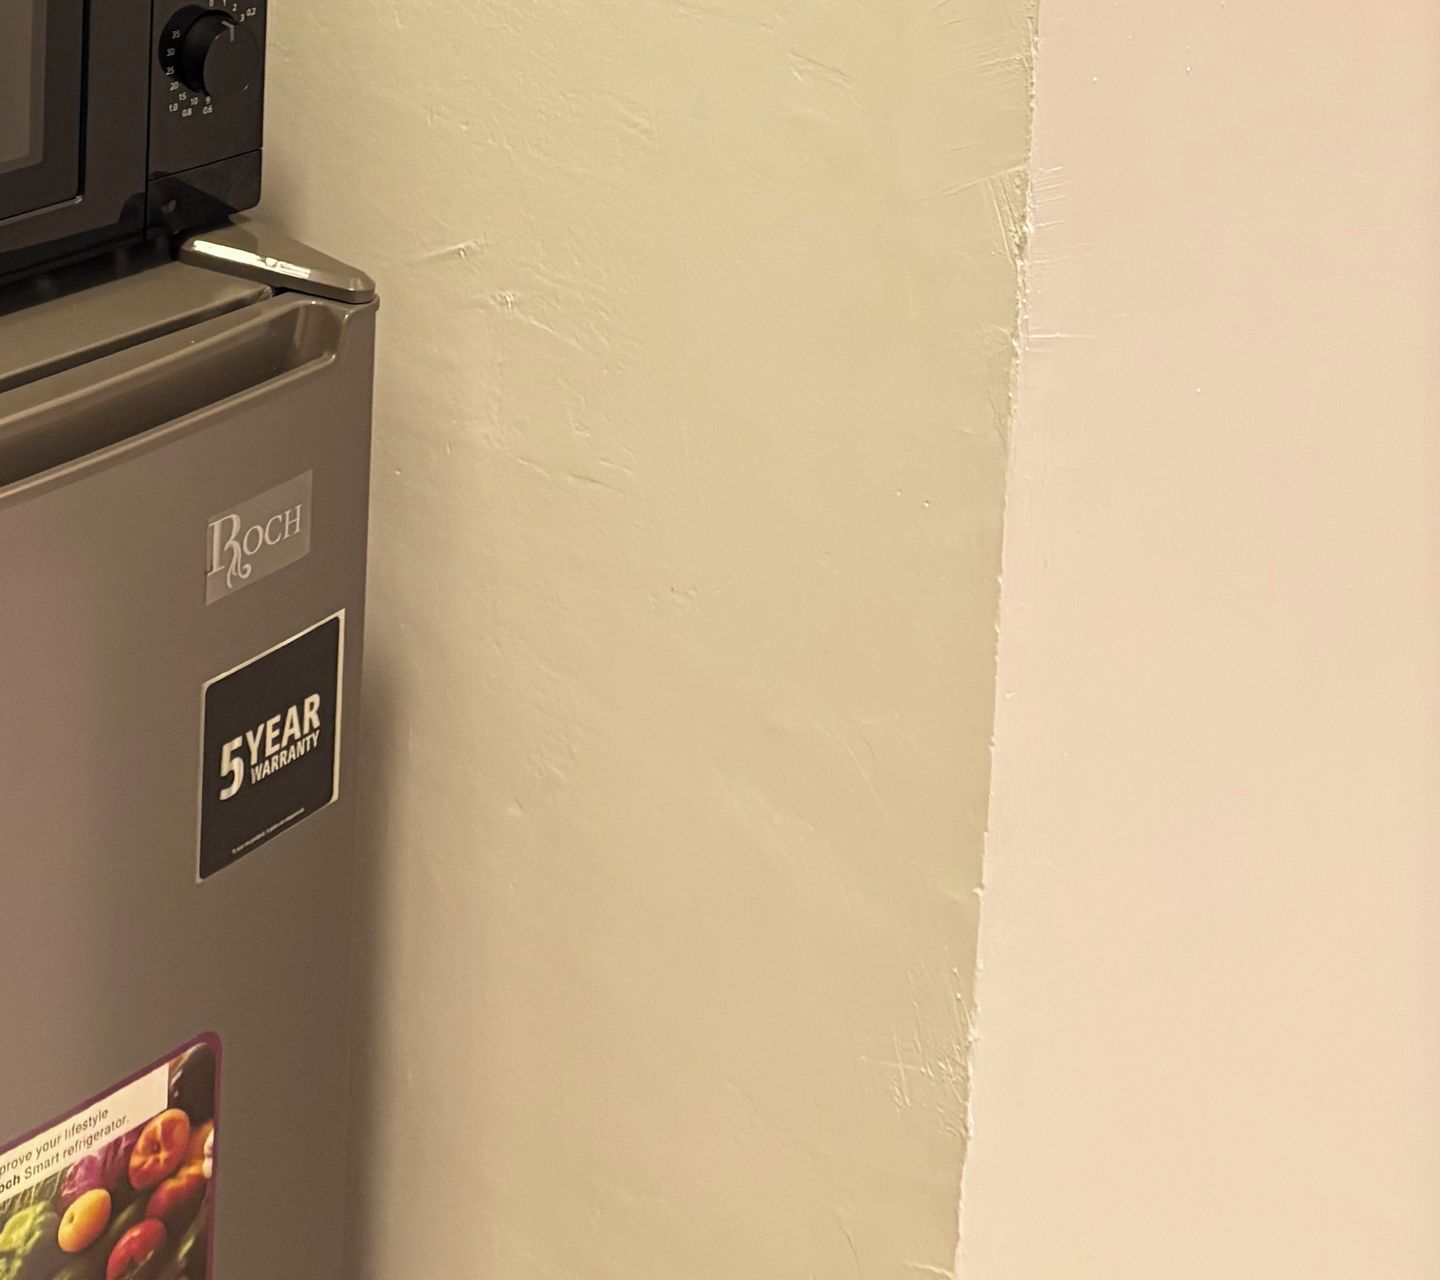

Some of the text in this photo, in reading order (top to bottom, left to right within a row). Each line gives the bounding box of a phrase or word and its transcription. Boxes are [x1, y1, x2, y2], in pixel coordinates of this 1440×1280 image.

[209, 0, 214, 7] 0
[232, 3, 237, 12] 2
[240, 13, 245, 22] 3
[166, 66, 174, 75] 25
[169, 81, 179, 91] 20
[179, 91, 187, 100] 15
[190, 97, 199, 106] 10
[207, 504, 302, 588] ROCH
[219, 693, 320, 800] 5 YEAR
[251, 730, 320, 784] WARRANTY
[36, 1134, 61, 1159] your
[64, 1109, 109, 1140] lifestyle
[24, 1153, 60, 1180] Smart
